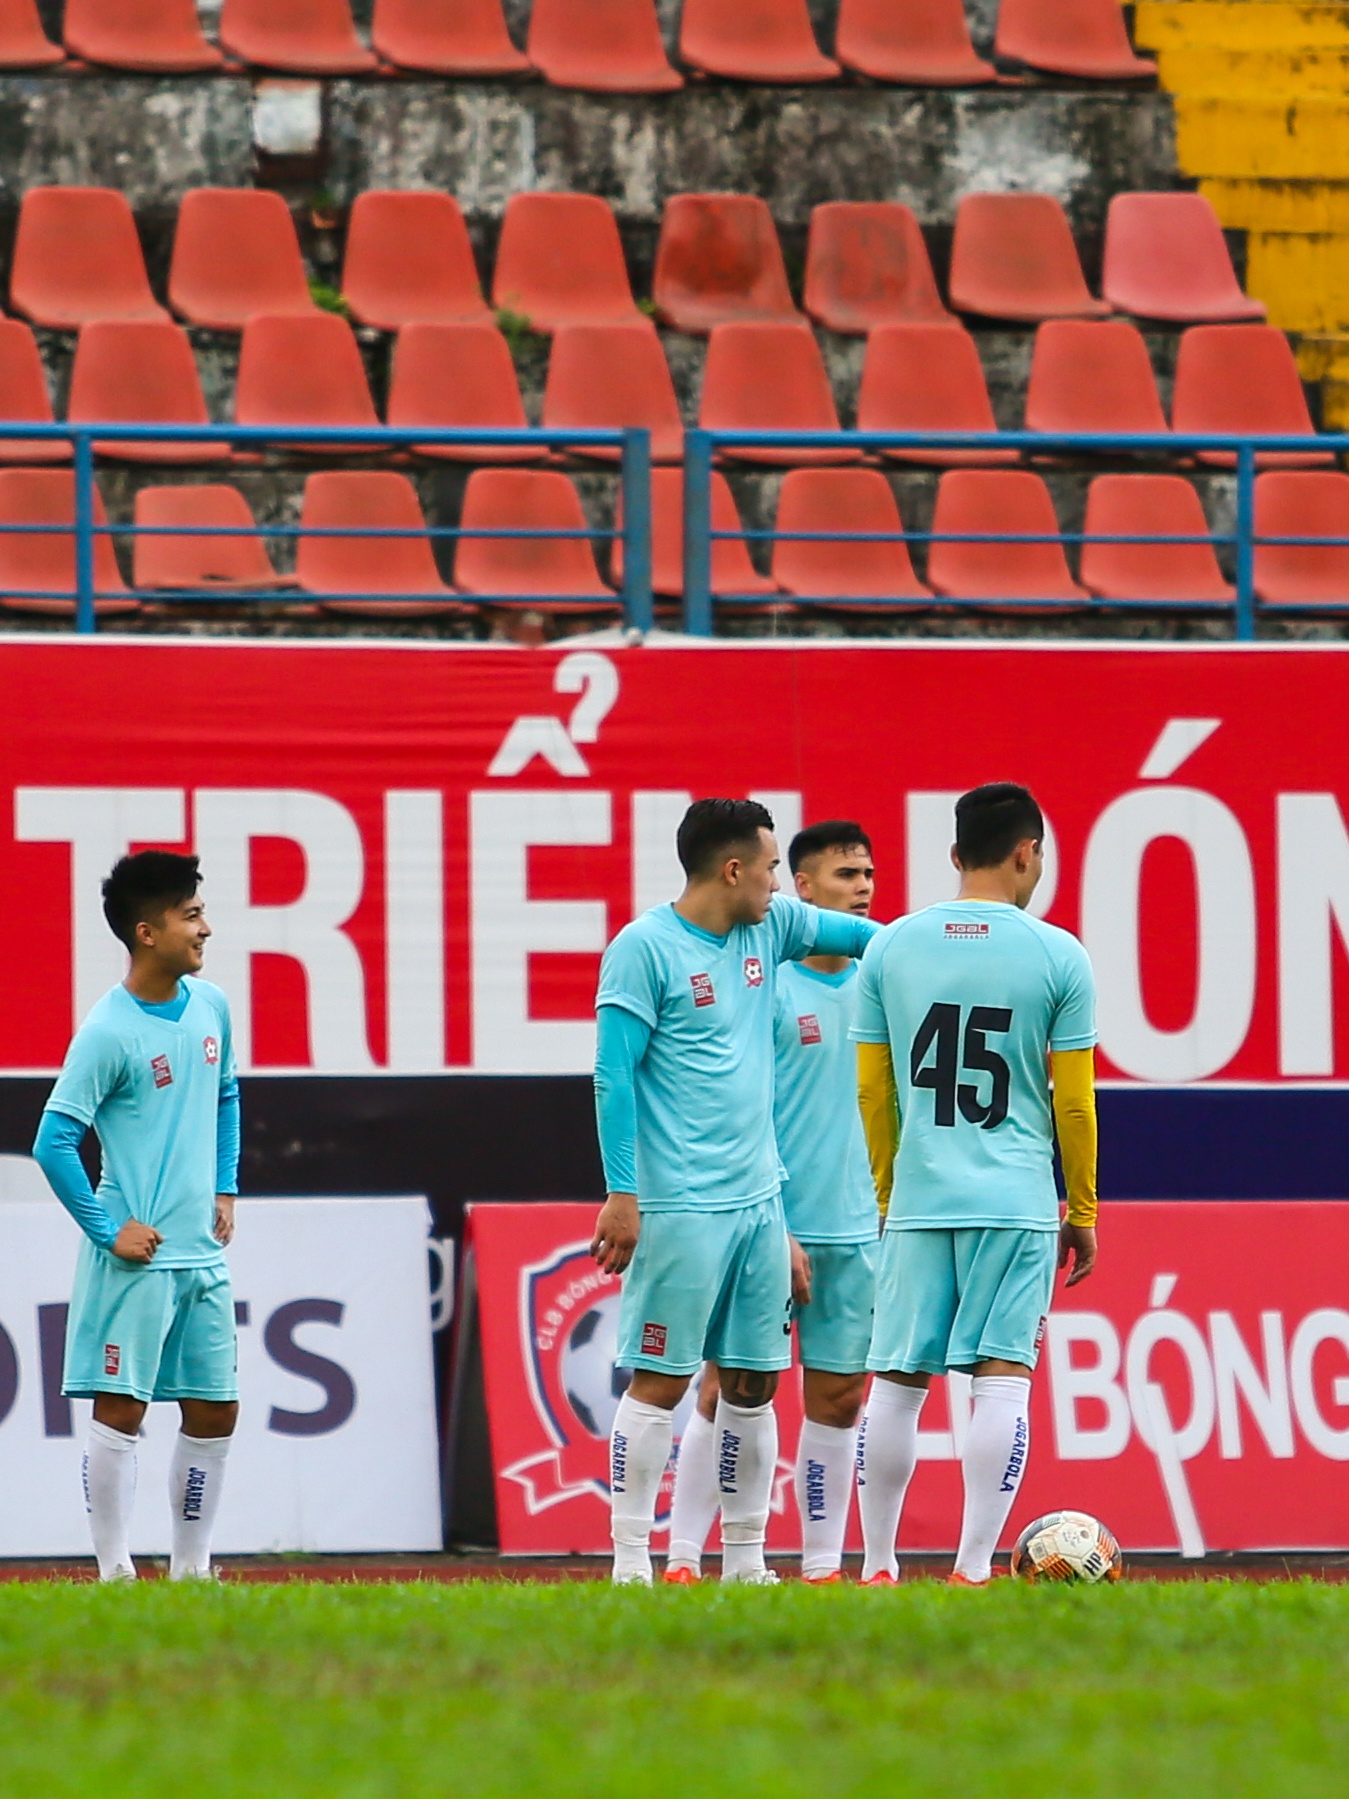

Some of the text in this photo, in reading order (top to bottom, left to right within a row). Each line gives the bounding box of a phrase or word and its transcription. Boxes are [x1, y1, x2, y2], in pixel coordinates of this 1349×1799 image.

[910, 1002, 1013, 1130] 45
[612, 1430, 629, 1494] JOGARBOLA
[719, 1429, 742, 1494] JOGARBOLA
[1000, 1416, 1028, 1492] JOGARBOLA
[806, 1458, 827, 1522] JOGARBOLA
